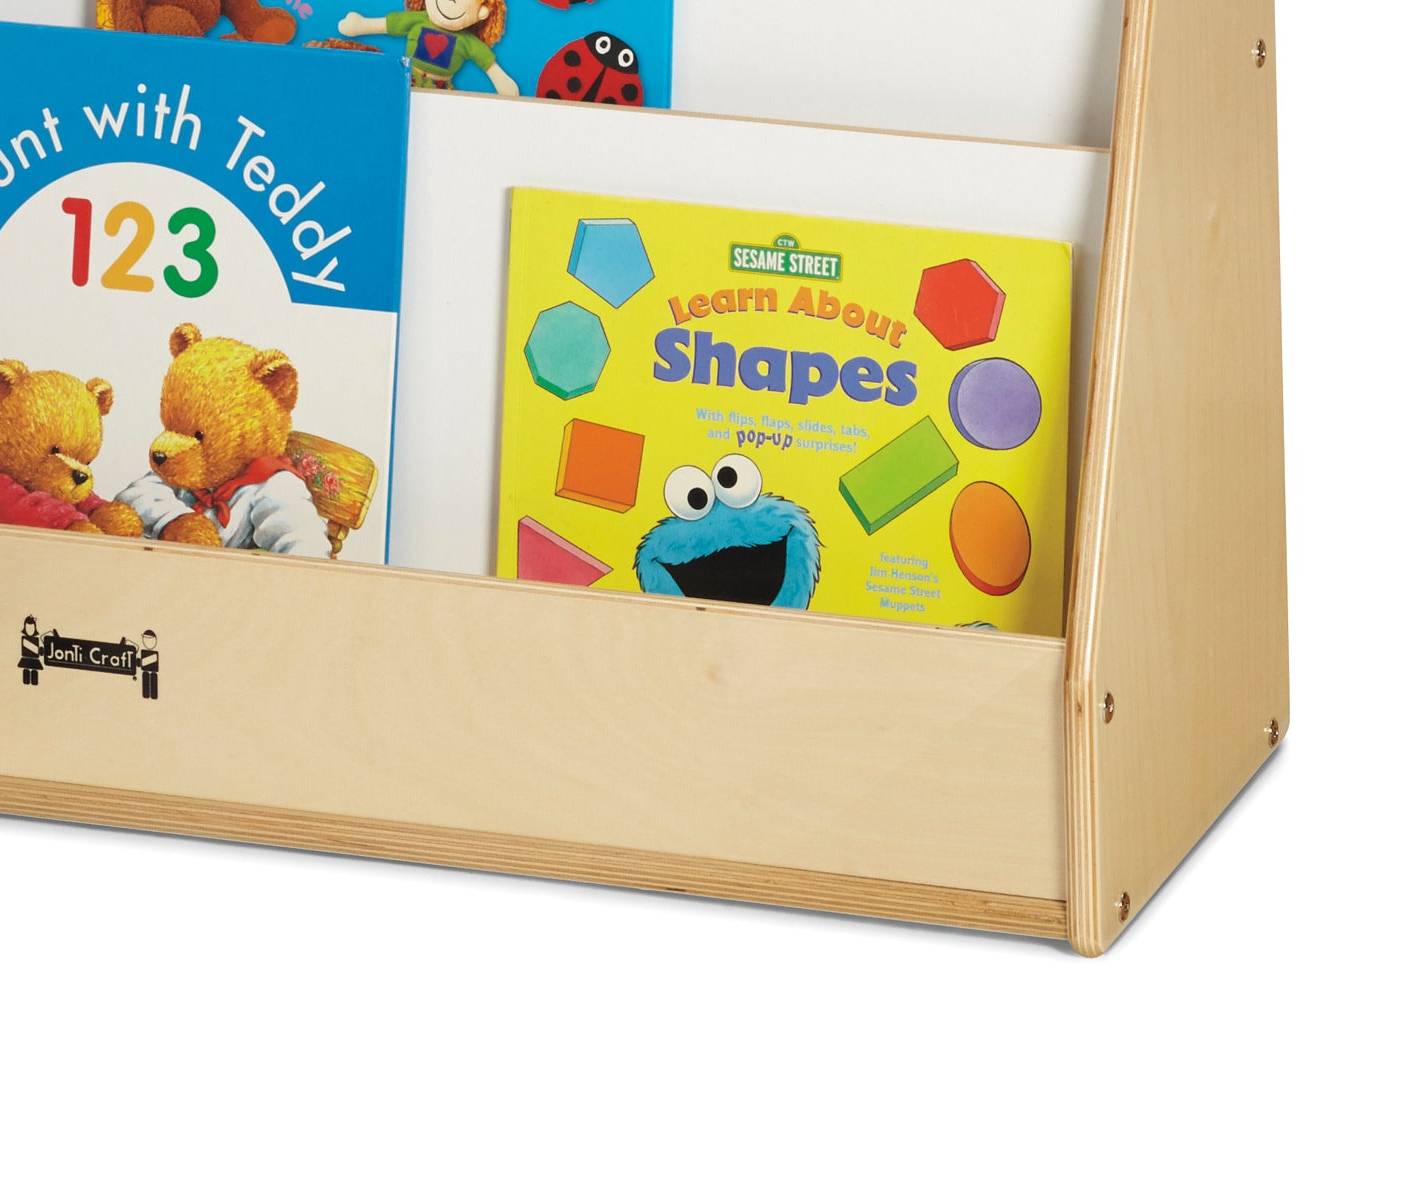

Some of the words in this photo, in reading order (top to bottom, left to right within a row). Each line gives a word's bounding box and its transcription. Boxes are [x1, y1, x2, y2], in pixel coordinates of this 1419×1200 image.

[83, 83, 203, 151] with
[226, 115, 352, 292] Teddy
[61, 197, 220, 299] 123
[777, 238, 795, 247] CTW
[733, 247, 786, 272] SESAME
[789, 253, 839, 277] STREET
[667, 286, 778, 327] Learn
[788, 286, 908, 349] About
[652, 327, 918, 407] Shapes
[695, 407, 724, 422] With
[728, 411, 757, 427] flips,
[761, 415, 794, 431] flaps,
[798, 420, 837, 436] slides,
[841, 425, 871, 439] tabs,
[707, 428, 731, 440] and
[736, 429, 794, 450] pop-up
[796, 438, 858, 453] surprises!
[880, 552, 929, 570] featuring
[869, 566, 888, 578] Jim
[891, 568, 939, 584] Henson's
[866, 580, 907, 595] Sesame
[909, 585, 941, 599] Street
[880, 597, 926, 612] Muppets
